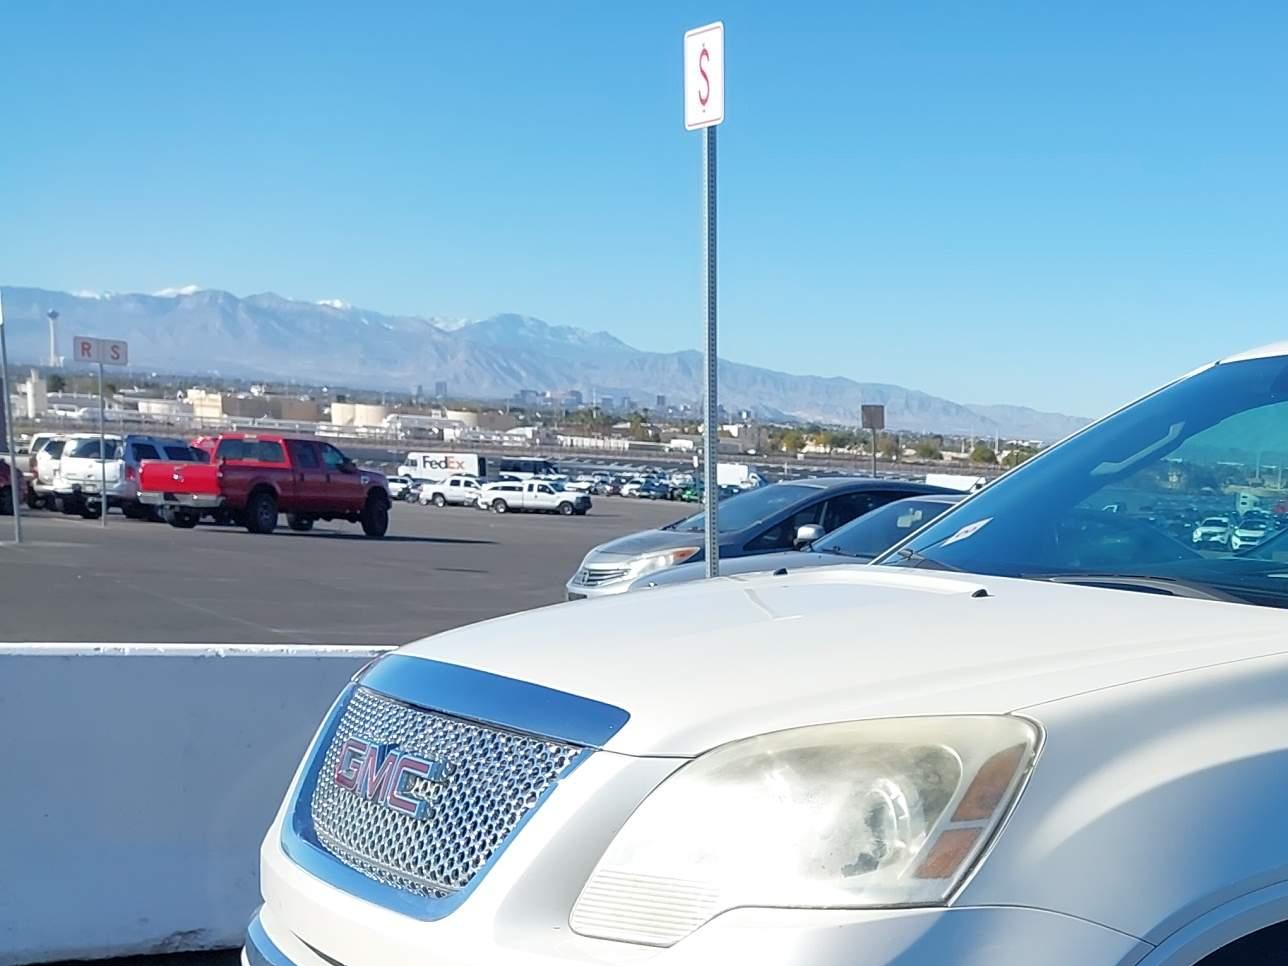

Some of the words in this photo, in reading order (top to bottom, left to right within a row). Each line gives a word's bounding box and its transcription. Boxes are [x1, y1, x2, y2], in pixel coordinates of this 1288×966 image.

[698, 47, 710, 107] S
[81, 342, 92, 358] R
[110, 344, 121, 361] S
[422, 456, 465, 470] FedEx
[335, 736, 434, 817] GMC
